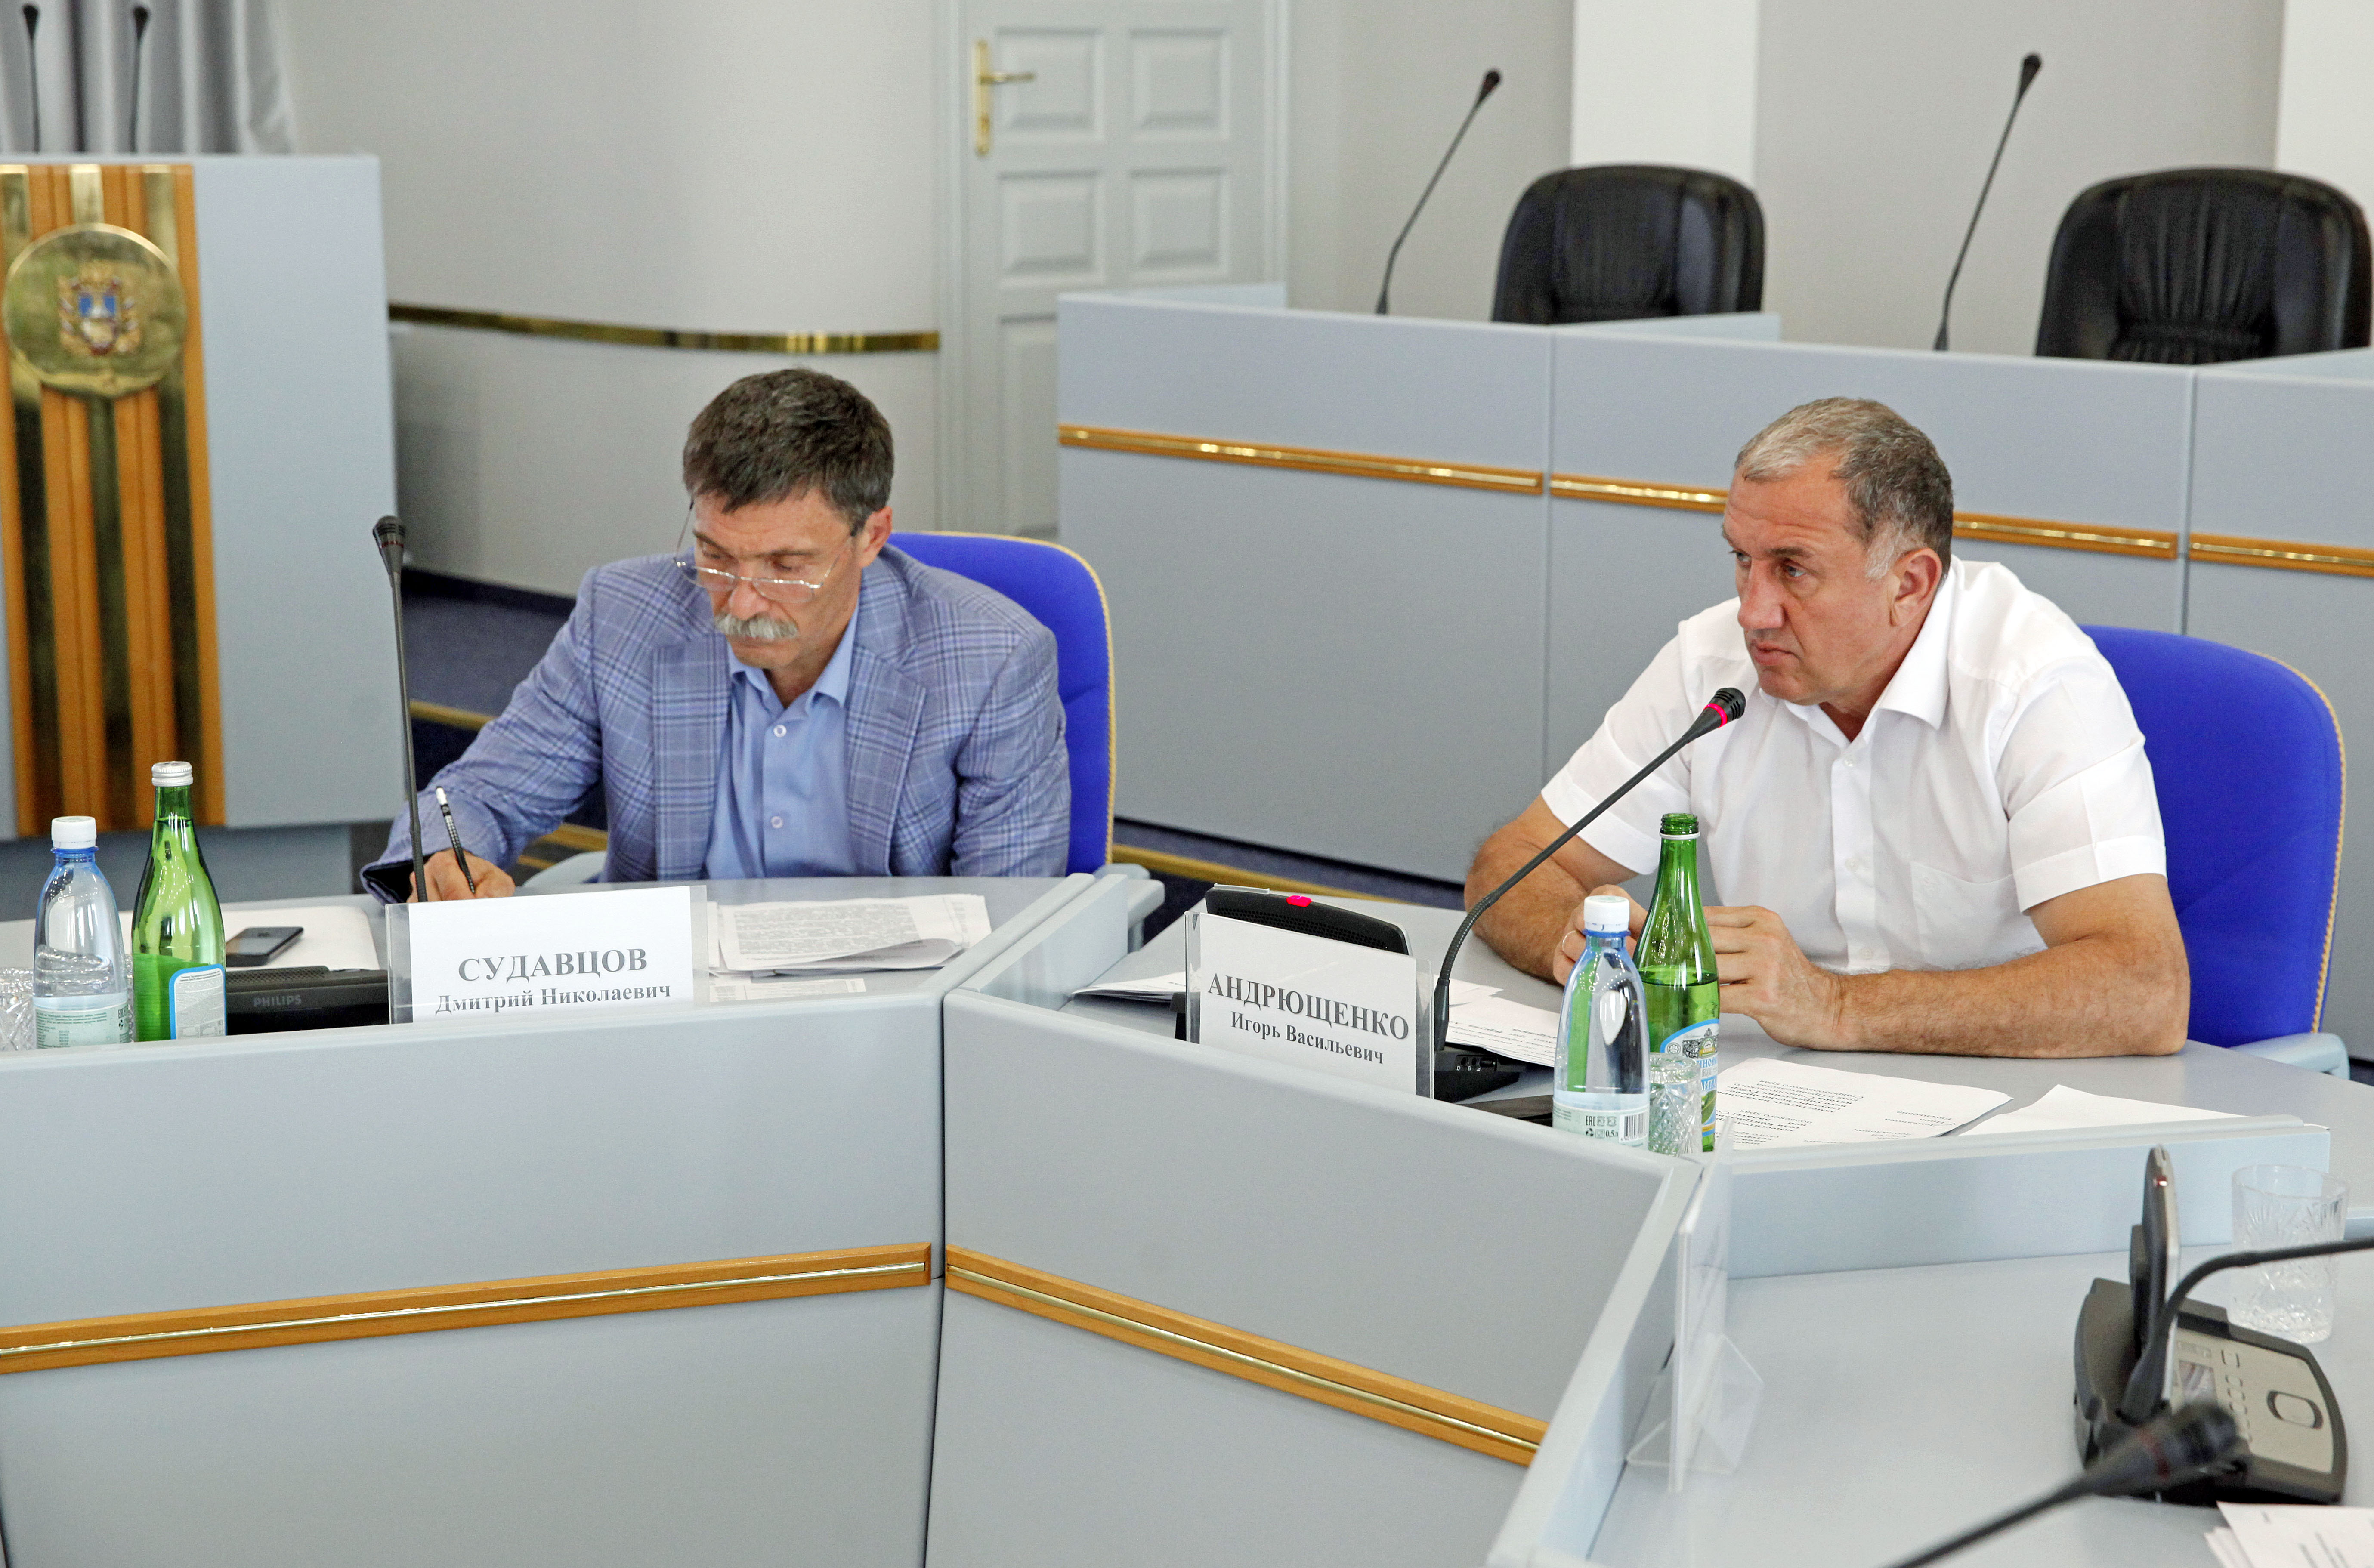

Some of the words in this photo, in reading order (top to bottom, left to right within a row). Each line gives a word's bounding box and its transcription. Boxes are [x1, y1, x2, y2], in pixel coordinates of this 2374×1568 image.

[458, 948, 647, 984] СУДАВЦОВ
[253, 994, 301, 1007] PHILIPS
[435, 990, 533, 1016] Дмитрий
[540, 985, 671, 1006] Николаевич
[1208, 972, 1409, 1040] АНДРЮЩЕНКО
[1231, 1011, 1281, 1040] Игорь
[1286, 1025, 1384, 1065] Васильевич
